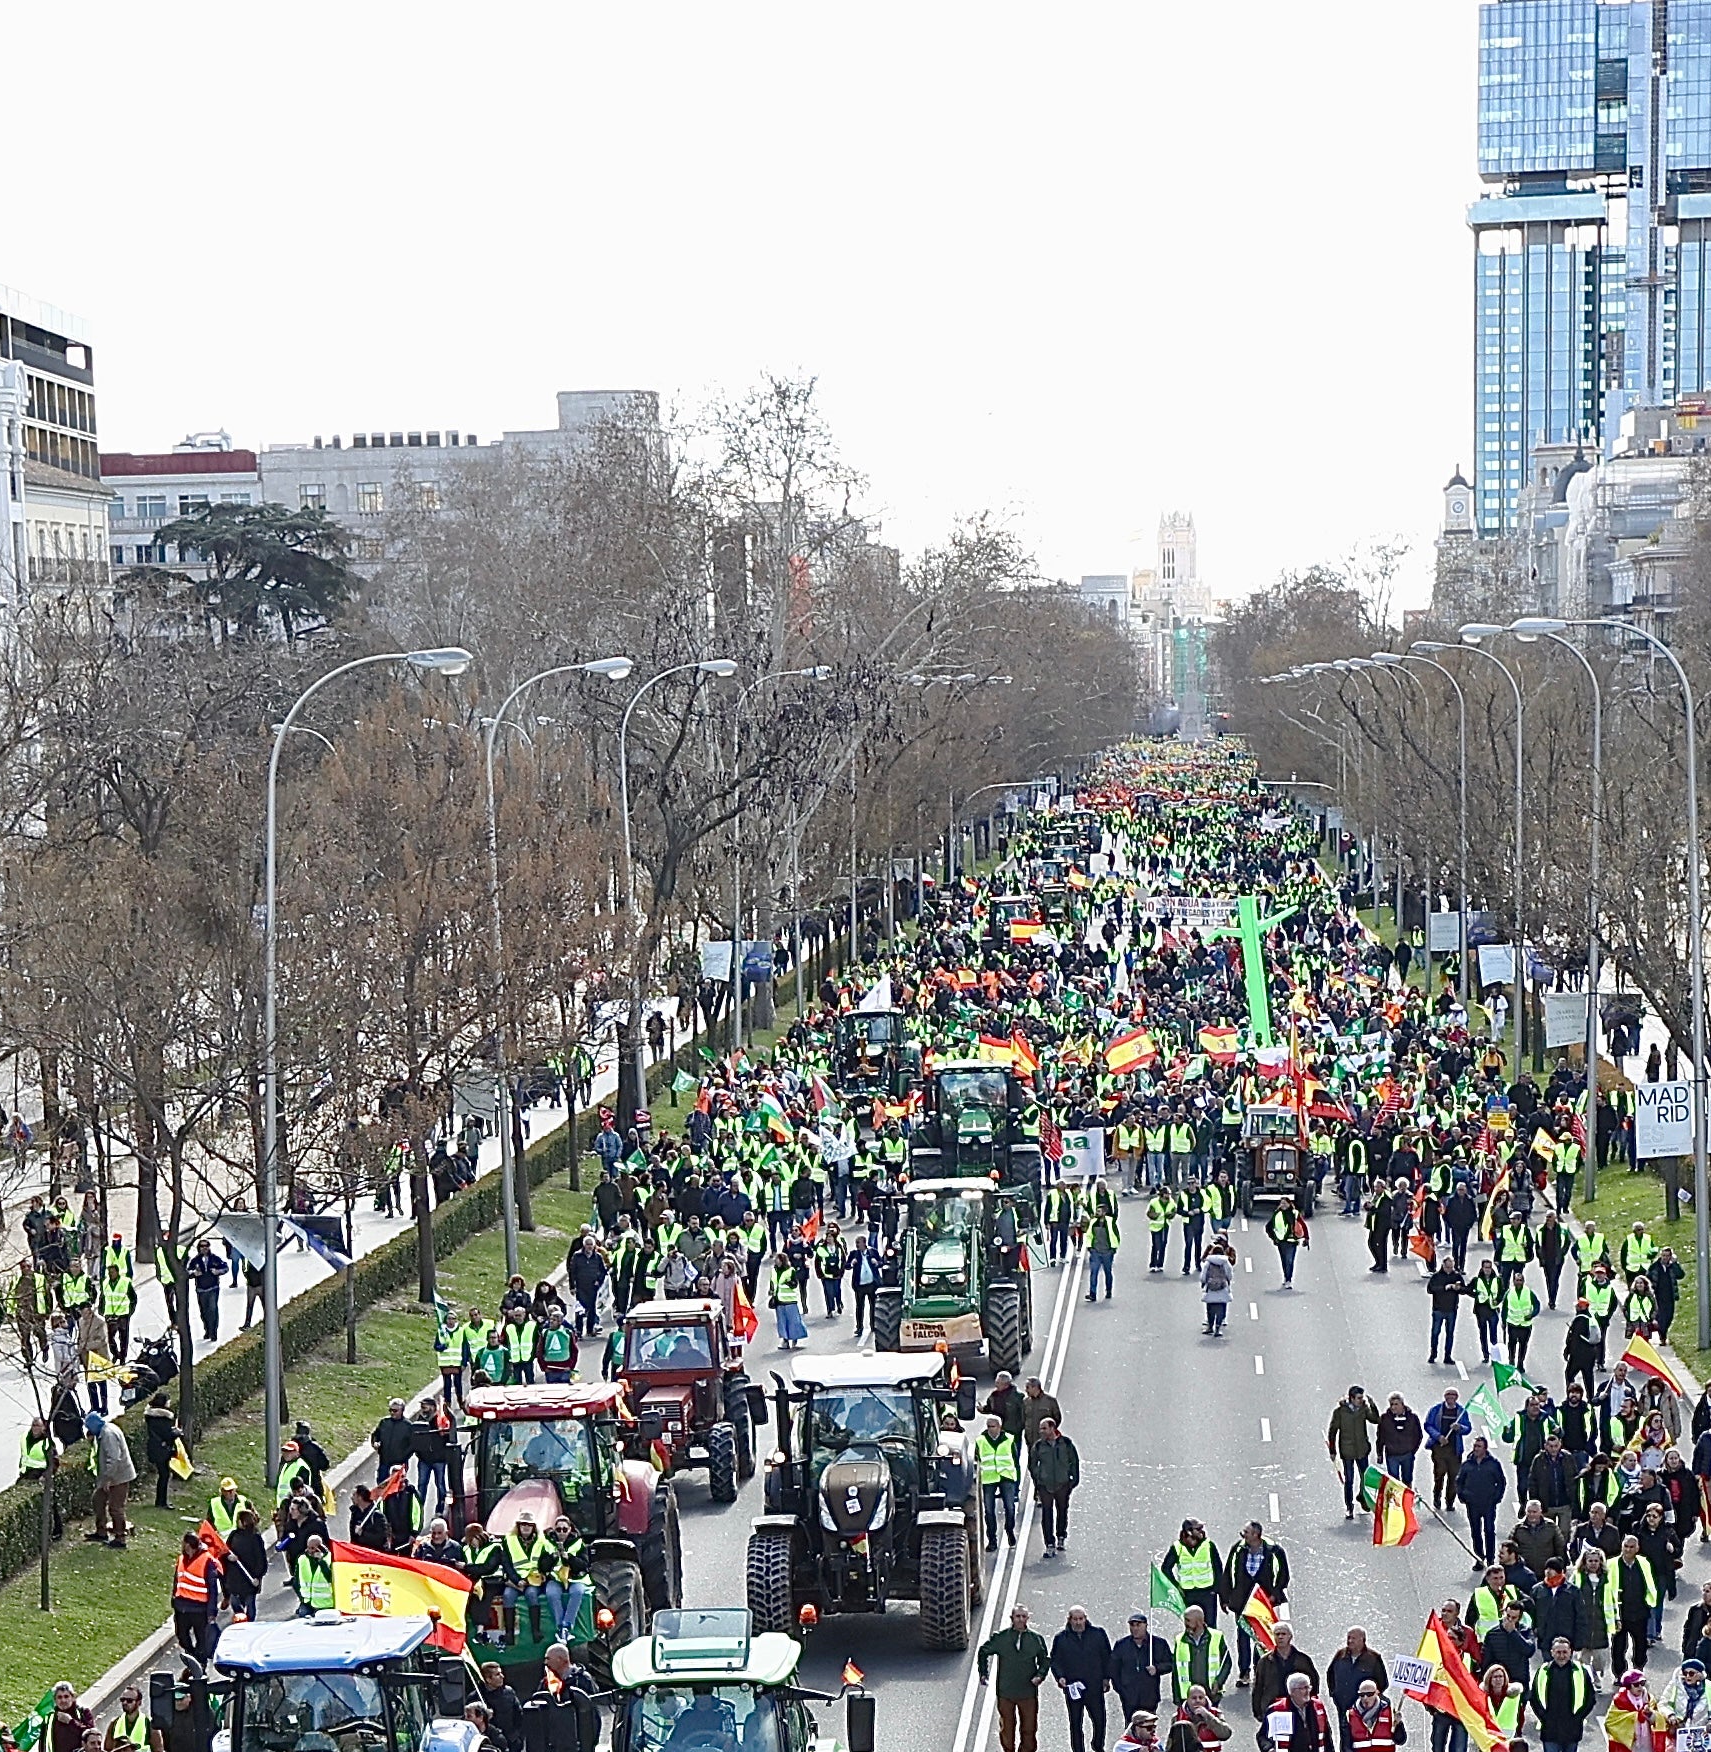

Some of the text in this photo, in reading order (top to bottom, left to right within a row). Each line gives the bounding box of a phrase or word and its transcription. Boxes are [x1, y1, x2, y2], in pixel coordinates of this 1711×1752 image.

[1638, 1086, 1689, 1107] MAD
[1657, 1104, 1690, 1123] RID
[912, 1323, 944, 1331] CAMPO
